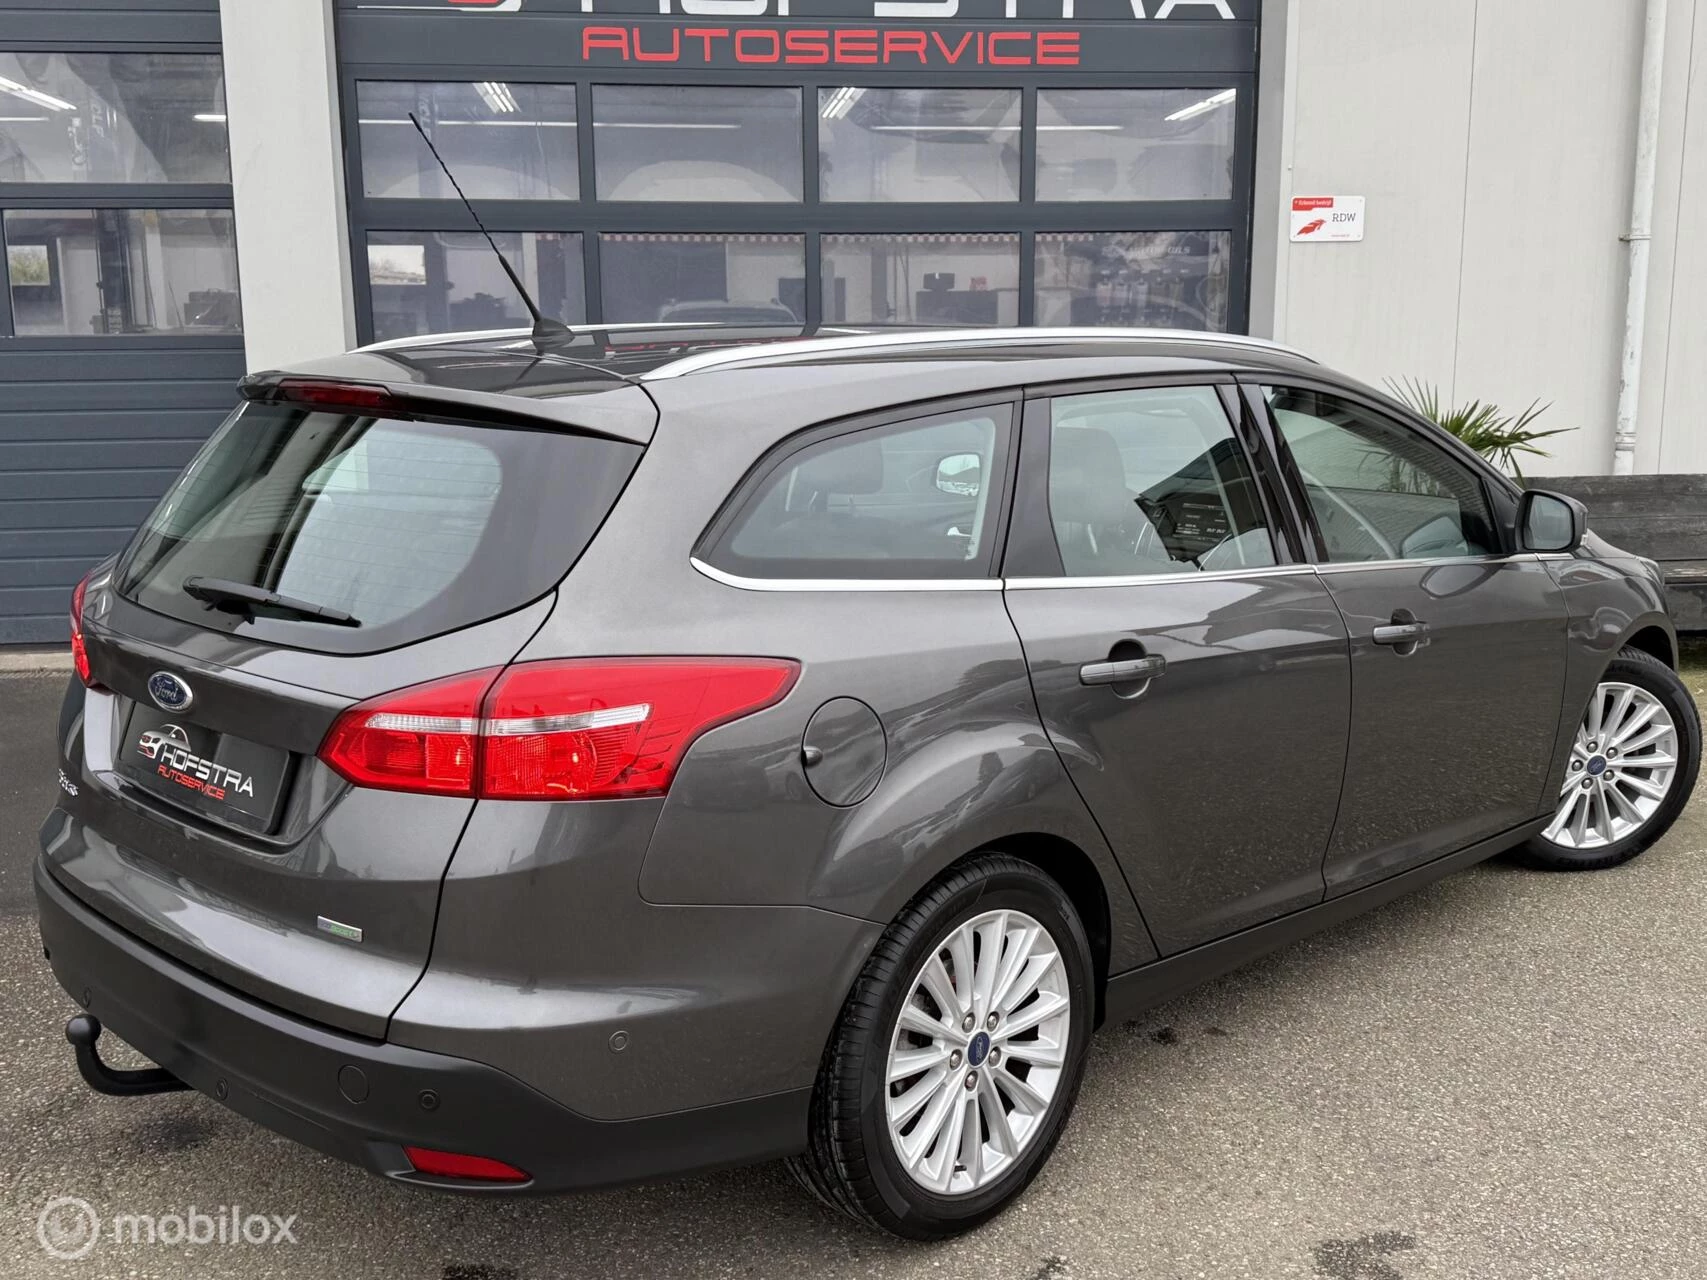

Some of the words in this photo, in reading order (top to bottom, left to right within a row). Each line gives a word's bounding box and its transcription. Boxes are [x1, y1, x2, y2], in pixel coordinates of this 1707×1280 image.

[582, 26, 1080, 65] AUTOSERVICE
[1332, 212, 1356, 223] RDW
[157, 763, 226, 801] AUTOSERVICE
[160, 744, 254, 798] HOFSTRA
